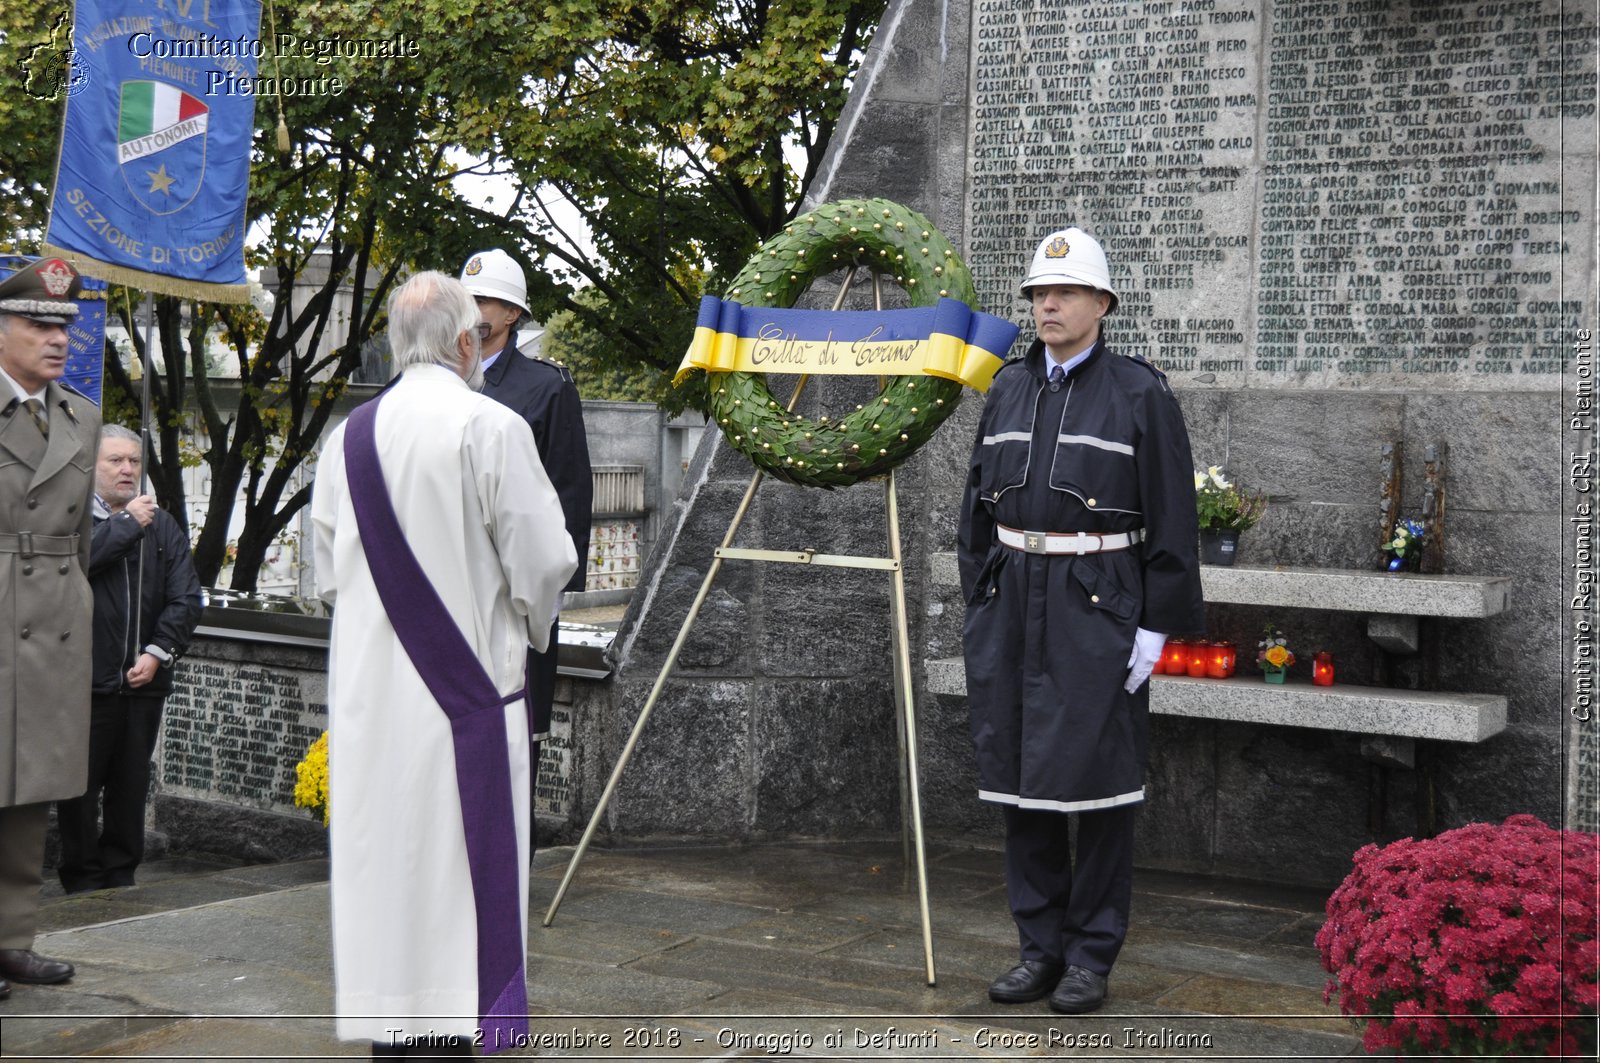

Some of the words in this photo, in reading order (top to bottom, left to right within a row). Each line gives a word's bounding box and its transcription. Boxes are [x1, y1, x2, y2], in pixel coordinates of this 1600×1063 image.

[978, 26, 1021, 39] CASAZZA
[1025, 24, 1065, 36] VIRGINIO
[1075, 20, 1117, 33] CASELLA
[1123, 18, 1148, 30] LUIGI
[1160, 14, 1203, 28] CASELLI
[1208, 10, 1255, 24] TEODORA
[979, 13, 1017, 26] CASARO
[1022, 10, 1067, 23] VITTORIA
[1082, 6, 1128, 20] CASASSA
[977, 53, 1016, 65] CASSANI
[1021, 50, 1068, 63] CATERINA
[1078, 47, 1120, 60] CASSANI
[1125, 46, 1155, 58] CELSO
[1166, 42, 1209, 55] CASSANI
[1216, 39, 1246, 52] PIERO
[978, 40, 1021, 53] CASETTA
[1030, 37, 1069, 49] AGNESE
[1086, 33, 1136, 46] CASNIGHI
[1145, 29, 1198, 43] RICCARDO
[140, 57, 199, 86] PIEMONTE
[976, 65, 1029, 79] CASSARINI
[1036, 62, 1095, 76] GIUSEPPINA
[1112, 59, 1148, 72] CASSIN
[1156, 56, 1204, 70] AMABILE
[976, 79, 1033, 92] CASSINELLI
[1041, 77, 1091, 89] BATTISTA
[1108, 72, 1173, 86] CASTAGNERI
[1181, 67, 1245, 81] FRANCESCO
[976, 92, 1038, 105] CASTAGNERI
[1047, 89, 1092, 102] MICHELE
[1108, 86, 1163, 99] CASTAGNO
[1172, 83, 1209, 96] BRUNO
[975, 106, 1020, 119] CASTAGNO
[1025, 104, 1079, 116] GIUSEPPINA
[1087, 101, 1135, 114] CASTAGNO
[1140, 100, 1160, 112] INES
[1170, 97, 1219, 110] CASTAGNO
[1224, 95, 1256, 108] MARIA
[975, 120, 1025, 132] CASTELLA
[1032, 117, 1073, 130] ANGELO
[1088, 113, 1167, 127] CASTELLACCIO
[1175, 110, 1218, 123] MANLIO
[122, 120, 199, 159] AUTONOMI
[974, 132, 1044, 145] CASTELLAZZI
[1051, 130, 1075, 143] LINA
[1092, 128, 1143, 141] CASTELLI
[1152, 125, 1205, 138] GIUSEPPE
[974, 146, 1019, 159] CASTELLO
[1023, 144, 1070, 157] CAROLINA
[1080, 142, 1126, 155] CASTELLO
[1131, 141, 1163, 153] MARIA
[1172, 138, 1214, 151] CASTINO
[1219, 136, 1252, 149] CARLO
[974, 160, 1017, 172] CASTINO
[1024, 158, 1075, 170] GIUSEPPE
[1092, 155, 1147, 168] CATTANEO
[1155, 153, 1204, 166] MIRANDA
[66, 188, 143, 258] SEZIONE
[151, 246, 170, 263] DI
[179, 223, 236, 264] TORINO
[972, 213, 1028, 226] CAVAGNERO
[1090, 210, 1151, 223] CAVALLERO
[1161, 208, 1203, 221] ANGELO
[1171, 248, 1222, 261] GIUSEPPE
[752, 322, 813, 366] Città
[818, 330, 839, 366] di
[1160, 346, 1198, 358] PIETRO
[1200, 360, 1243, 372] MENOTTI
